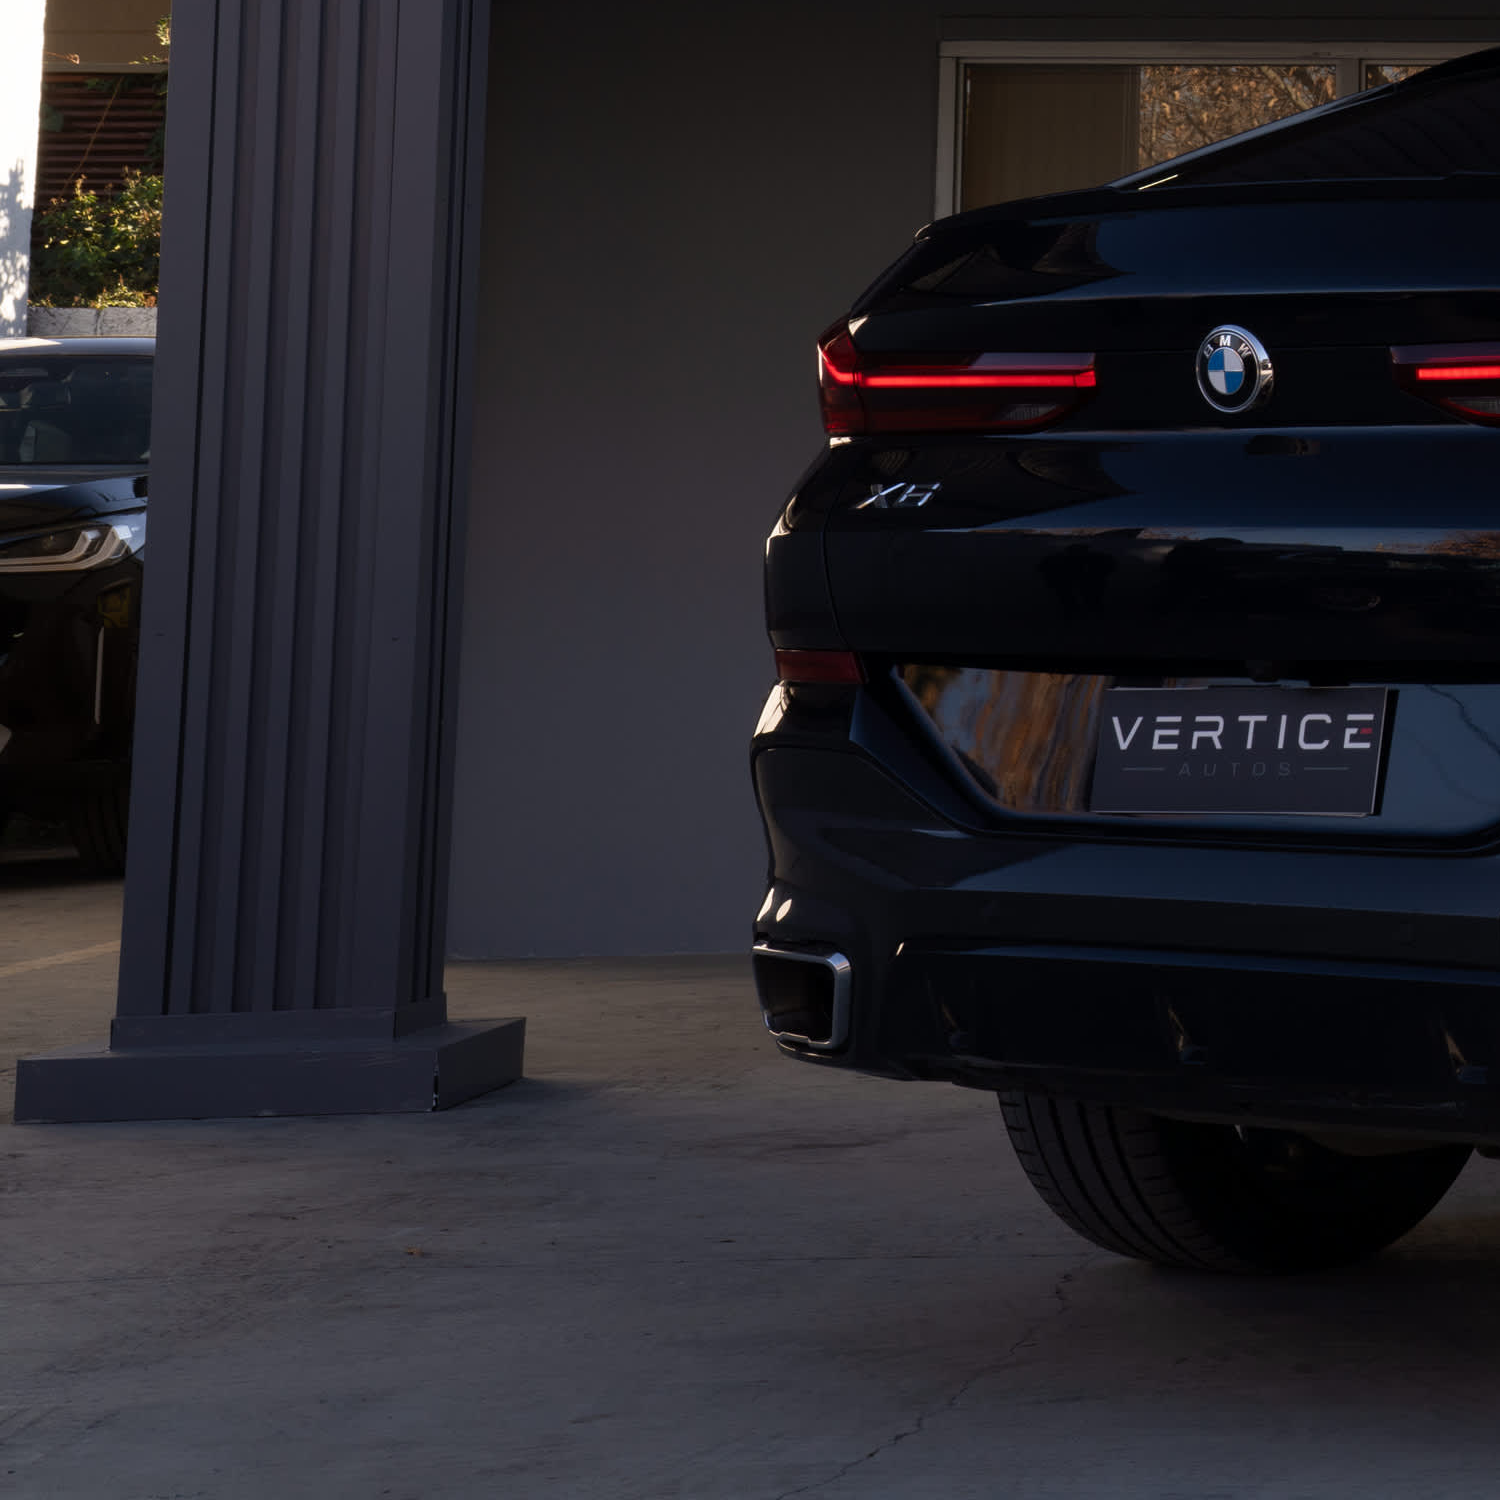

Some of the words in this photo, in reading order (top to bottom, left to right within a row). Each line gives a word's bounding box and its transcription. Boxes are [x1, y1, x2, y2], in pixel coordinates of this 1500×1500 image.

[1203, 334, 1252, 358] BMW
[855, 481, 942, 510] X6
[1111, 713, 1376, 751] VERTICE
[1177, 761, 1294, 778] AUTOS
